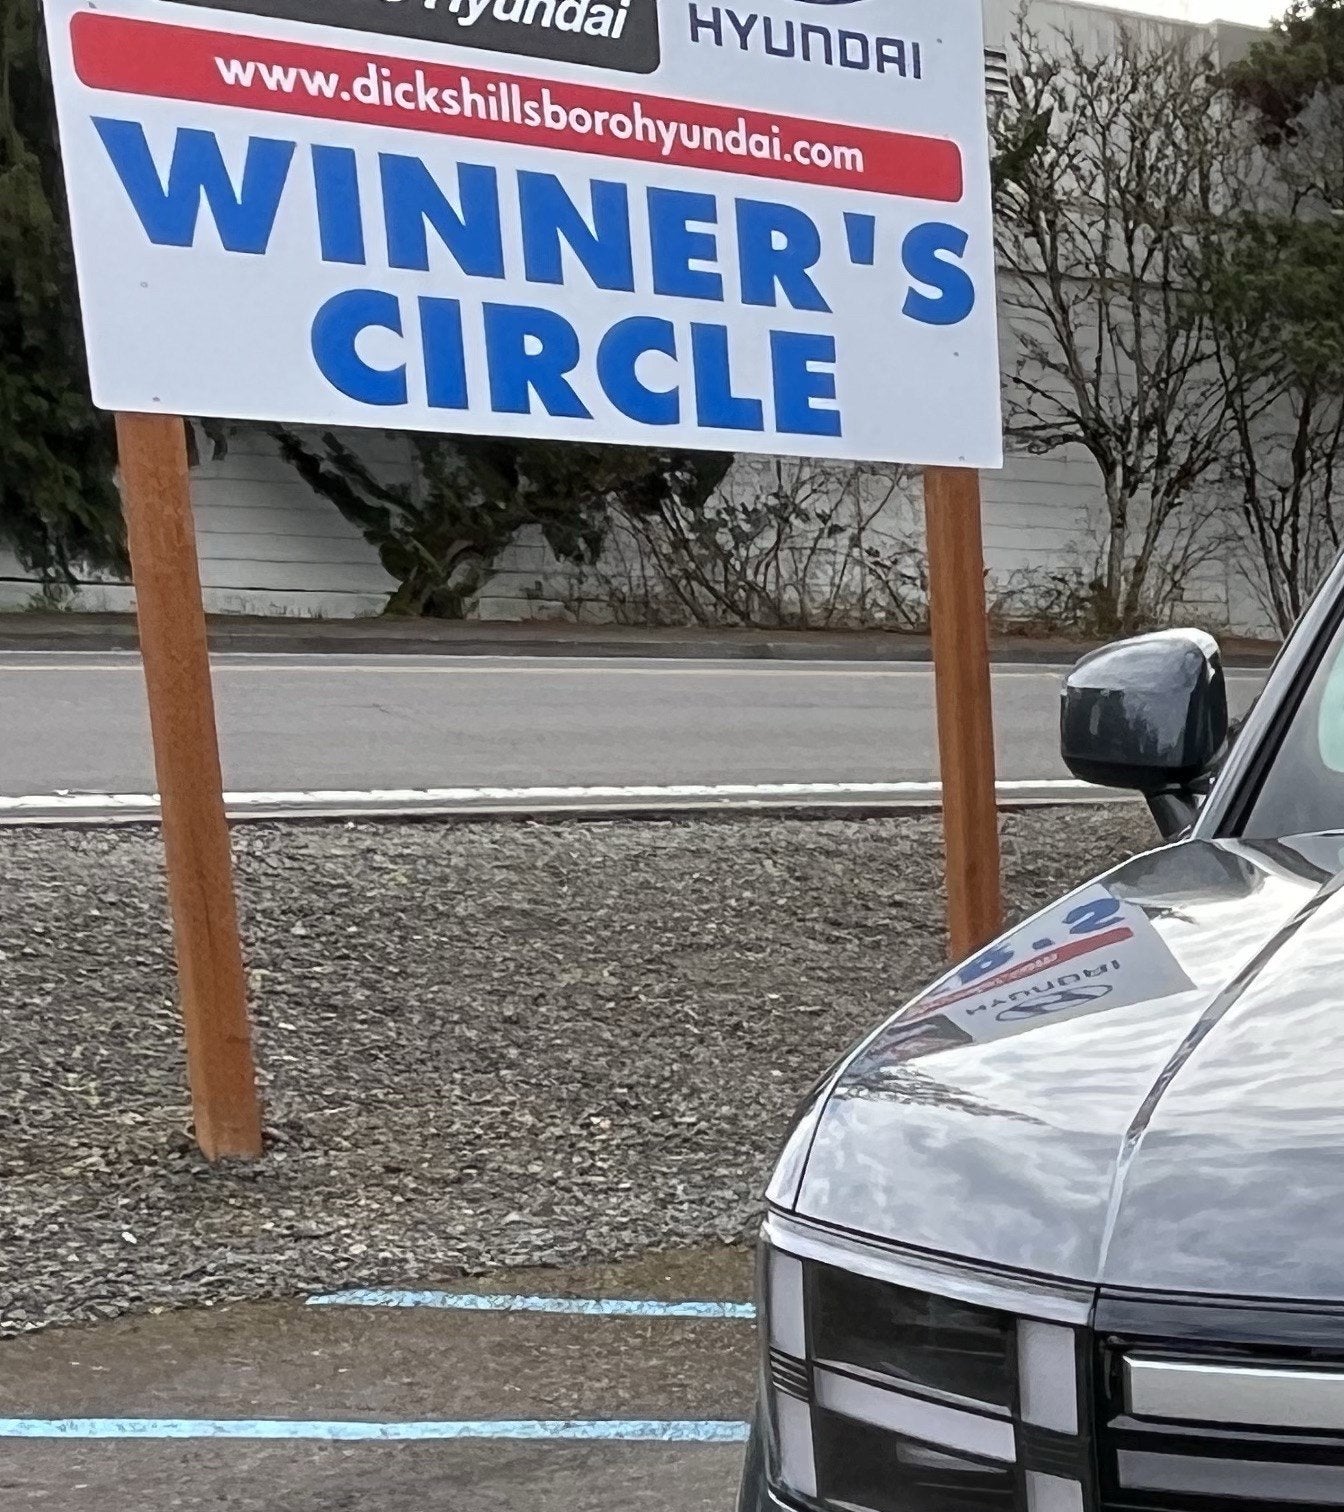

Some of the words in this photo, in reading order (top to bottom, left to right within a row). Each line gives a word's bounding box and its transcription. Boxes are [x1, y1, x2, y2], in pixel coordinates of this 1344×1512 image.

[688, 3, 922, 79] HYUNDAI
[215, 51, 865, 174] www.dickshillsborohyundai.com
[91, 116, 976, 325] WINNER'S
[311, 288, 843, 437] CIRCLE
